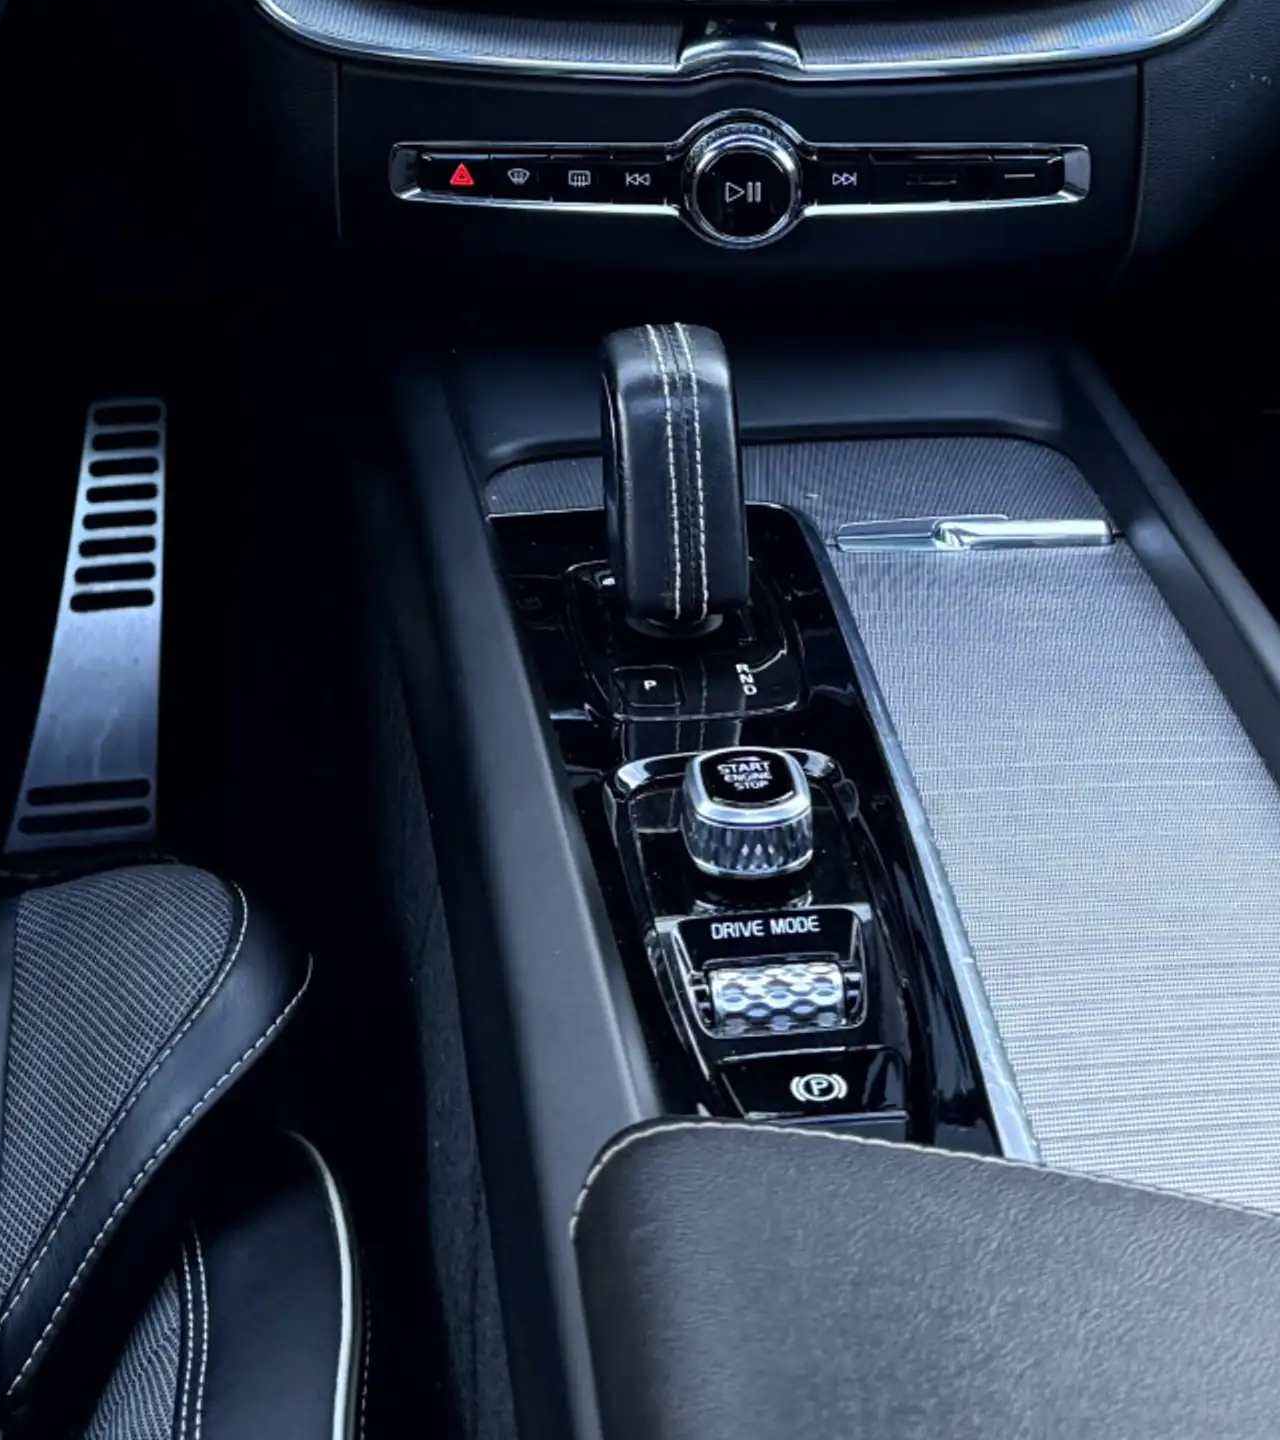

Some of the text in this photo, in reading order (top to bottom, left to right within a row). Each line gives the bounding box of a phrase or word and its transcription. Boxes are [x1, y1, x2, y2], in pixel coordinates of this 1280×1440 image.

[739, 672, 755, 685] N
[643, 679, 658, 692] P
[743, 683, 758, 696] D
[717, 760, 772, 775] START
[723, 771, 773, 784] ENGINE
[734, 779, 769, 791] STOP
[710, 915, 821, 940] DRIVE MODE
